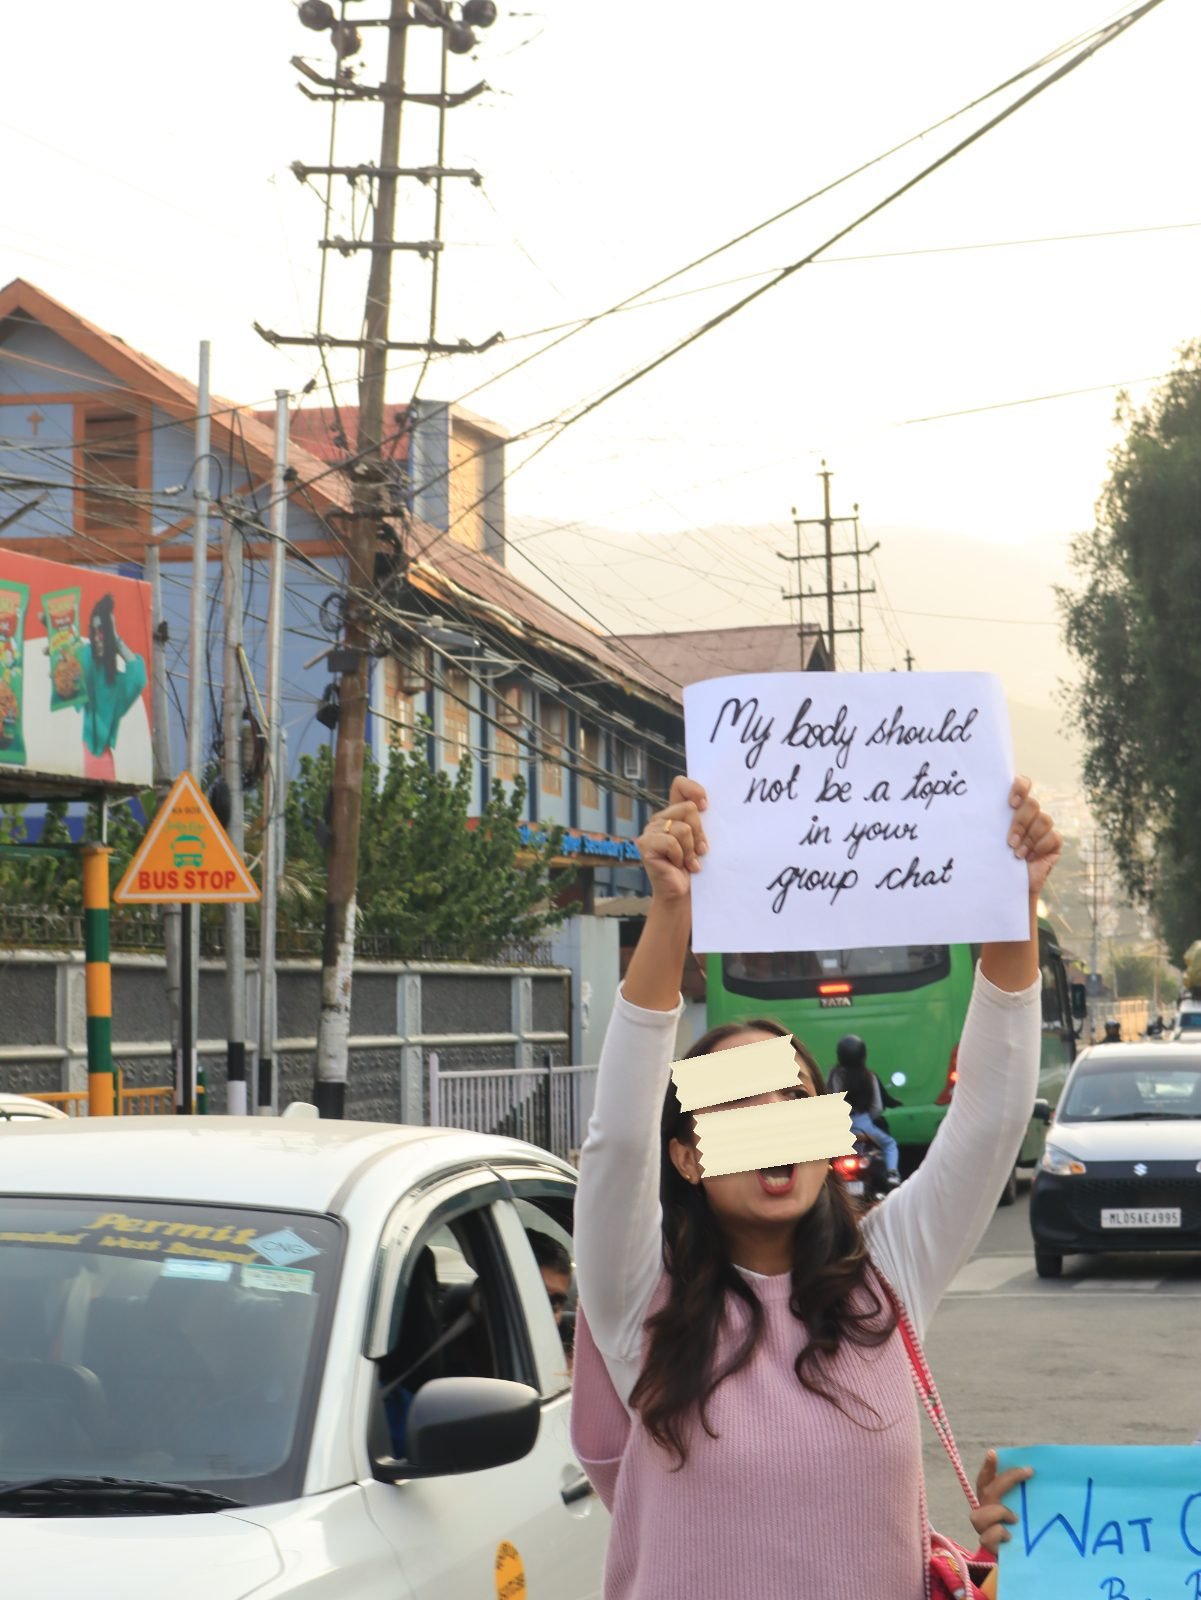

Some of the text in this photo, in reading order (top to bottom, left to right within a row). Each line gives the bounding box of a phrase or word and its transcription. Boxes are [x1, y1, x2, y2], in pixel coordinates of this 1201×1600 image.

[709, 697, 978, 769] My body should
[743, 761, 968, 810] not be a topic
[799, 815, 919, 860] in your
[138, 870, 236, 890] BUS STOP
[765, 856, 953, 914] group chat
[820, 996, 852, 1008] TATA
[81, 1212, 258, 1245] Permit
[1020, 1476, 1153, 1558] WAT
